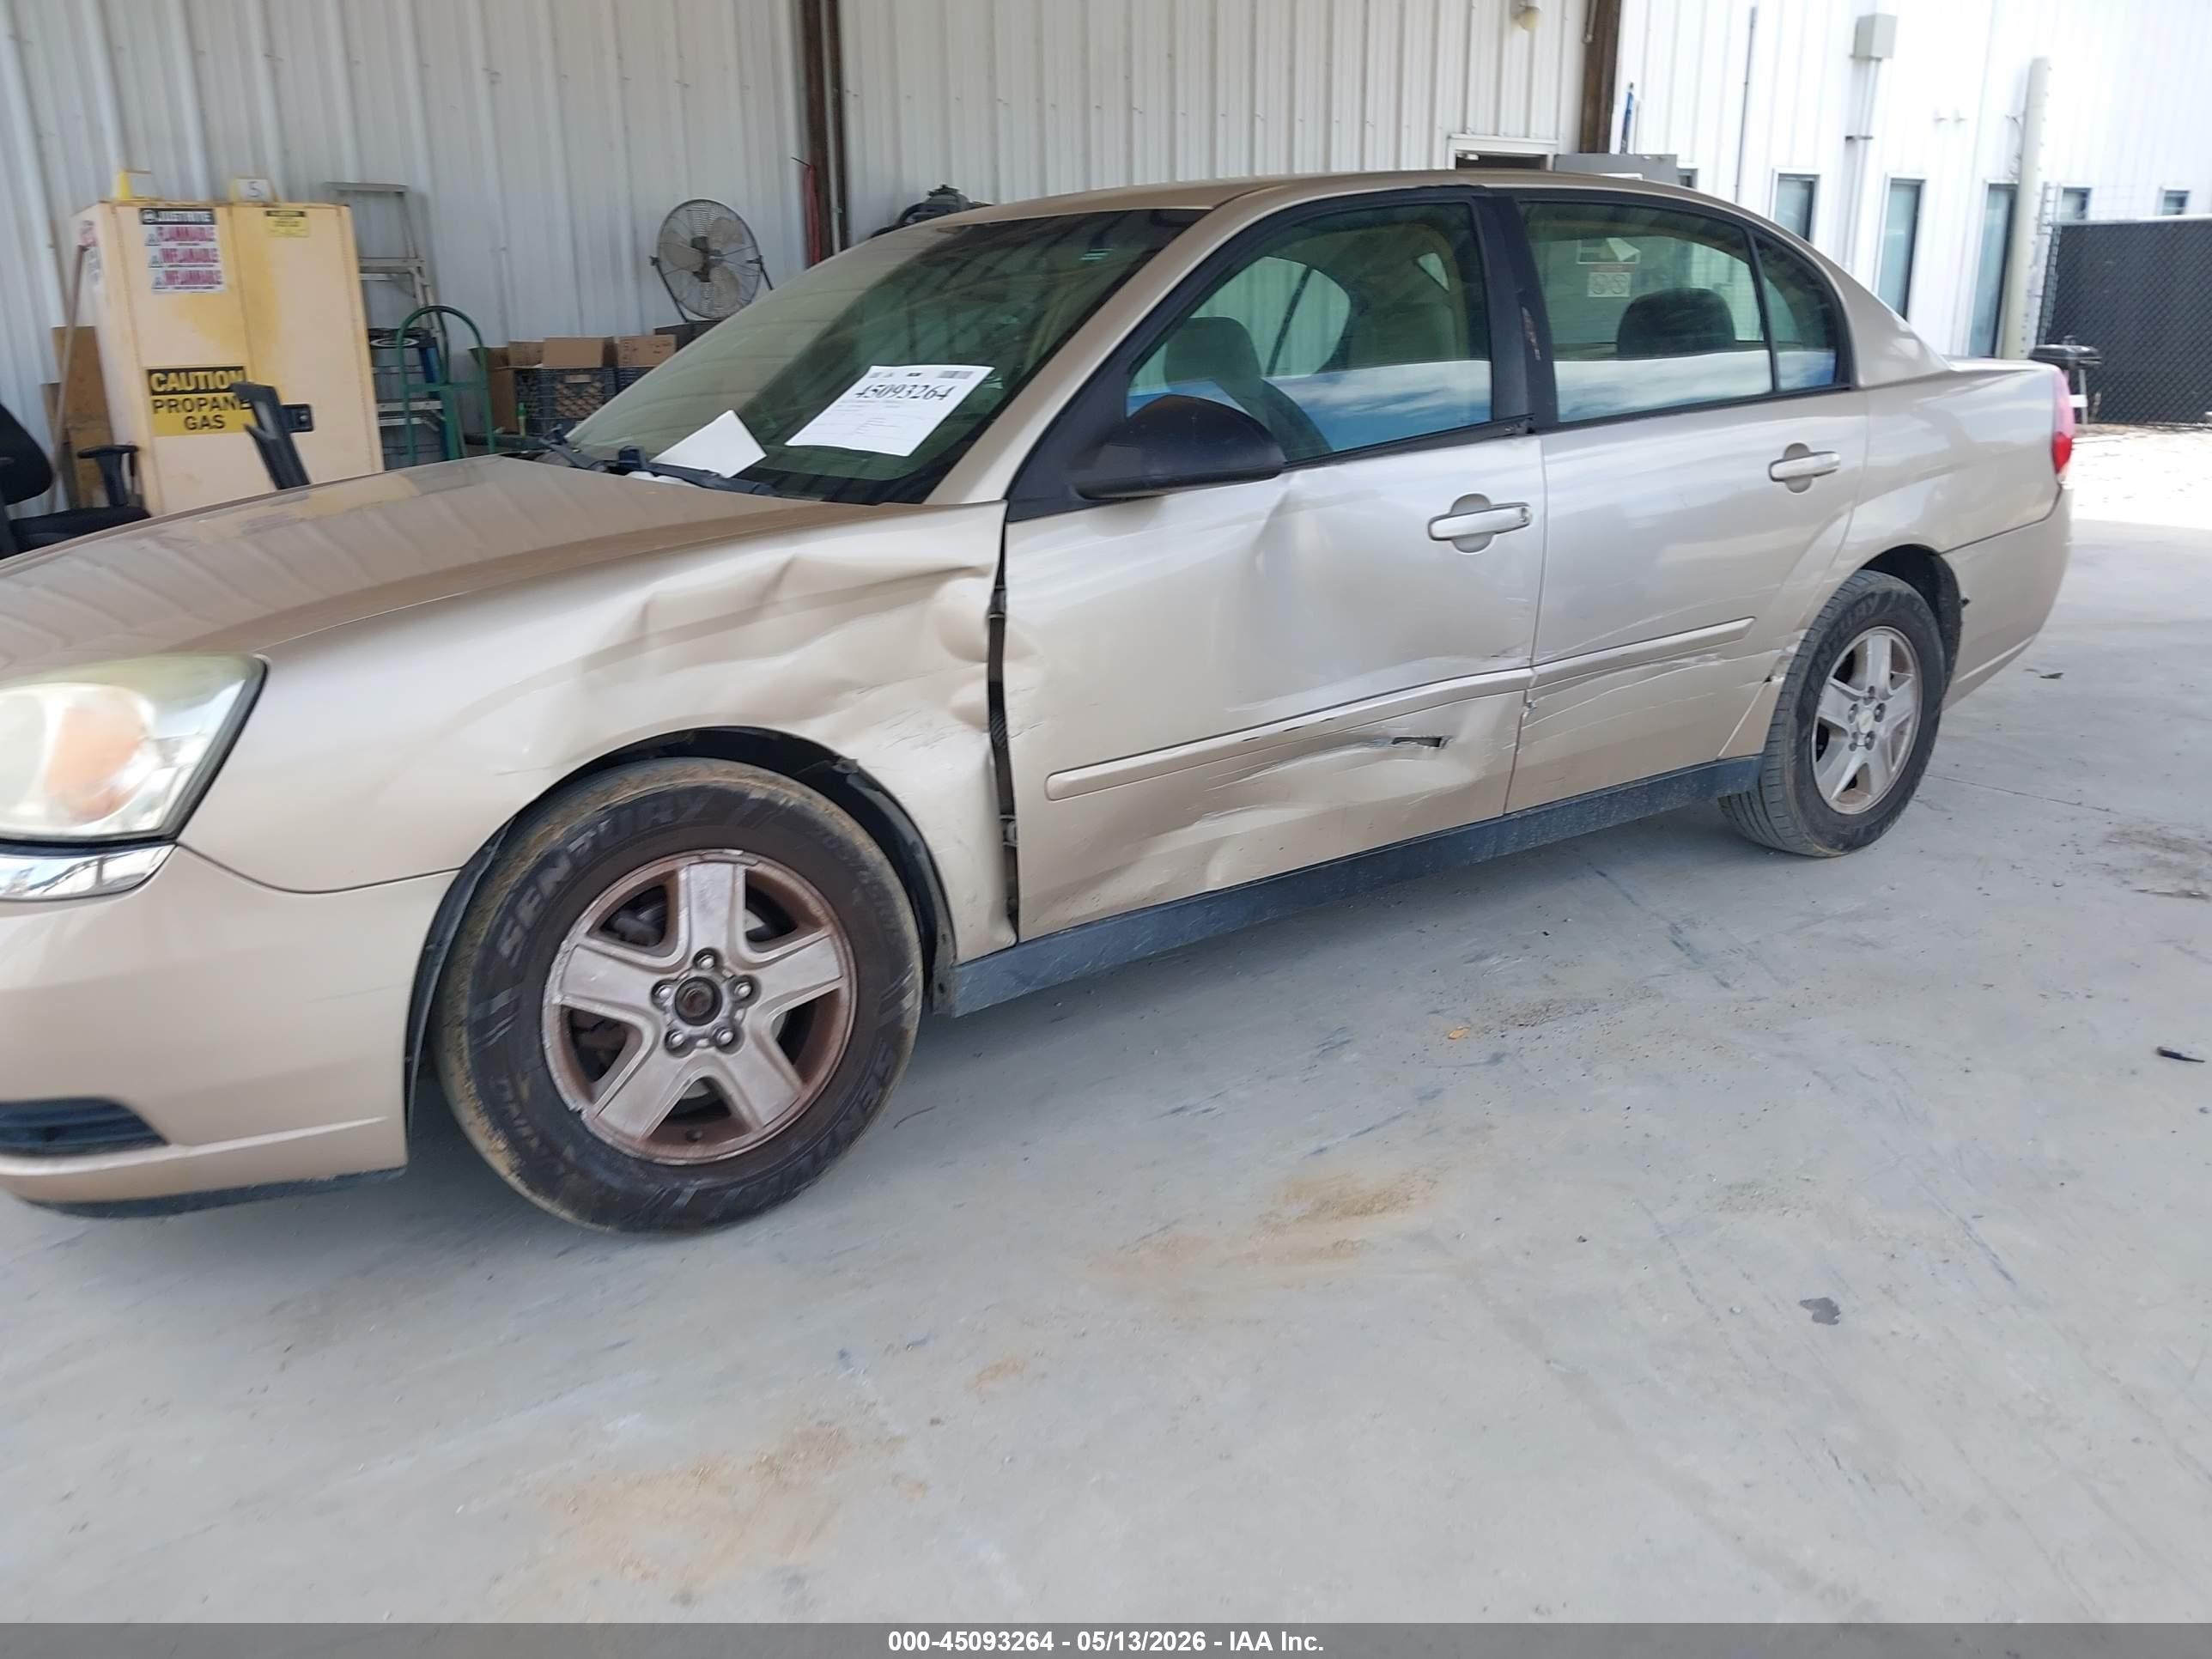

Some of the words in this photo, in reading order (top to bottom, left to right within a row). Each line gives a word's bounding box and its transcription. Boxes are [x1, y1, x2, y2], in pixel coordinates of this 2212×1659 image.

[248, 181, 261, 198] 5
[150, 369, 246, 393] CAUTION
[855, 384, 956, 401] 45093264
[184, 414, 226, 430] GAS
